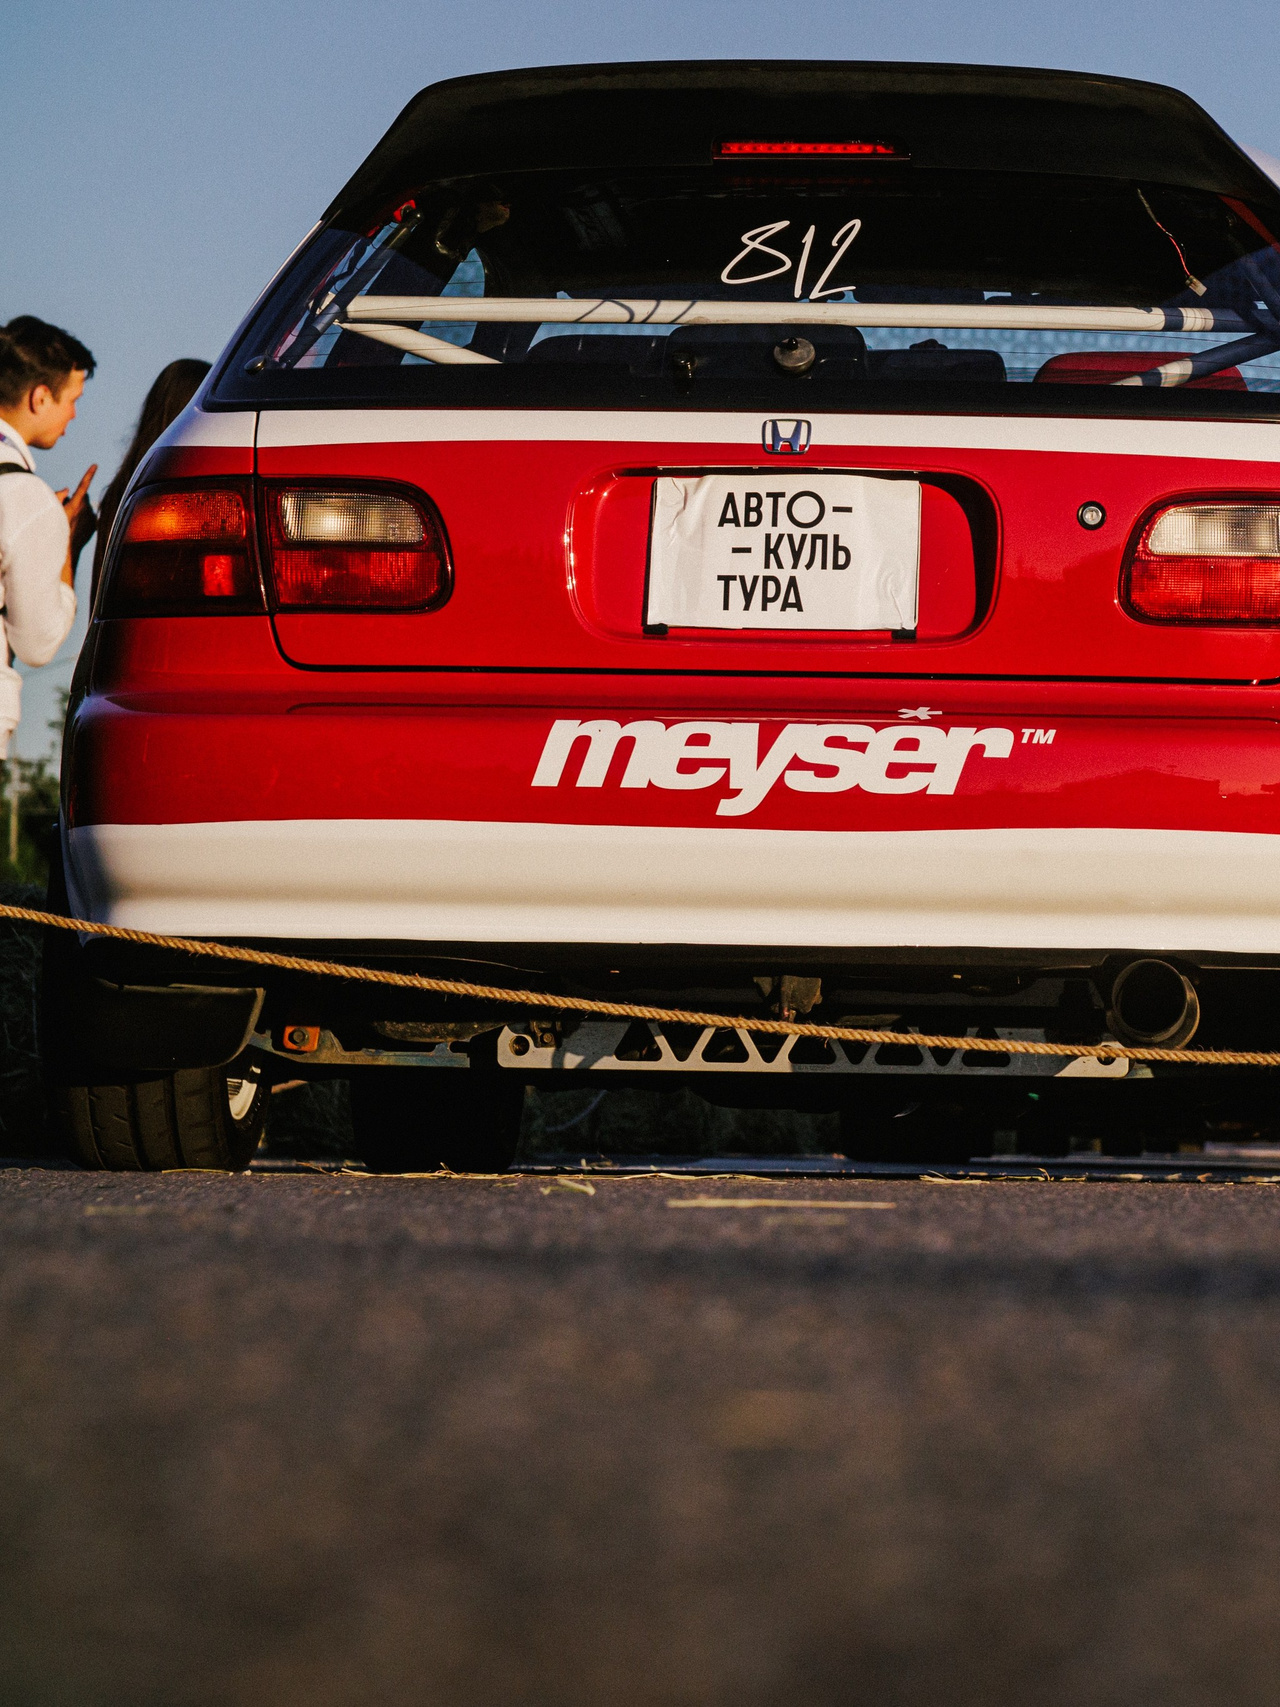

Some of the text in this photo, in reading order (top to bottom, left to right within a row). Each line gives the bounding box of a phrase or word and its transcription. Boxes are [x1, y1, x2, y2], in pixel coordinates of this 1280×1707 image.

[720, 218, 862, 300] 812
[717, 574, 804, 612] ТУРА
[530, 719, 1014, 817] meyser
